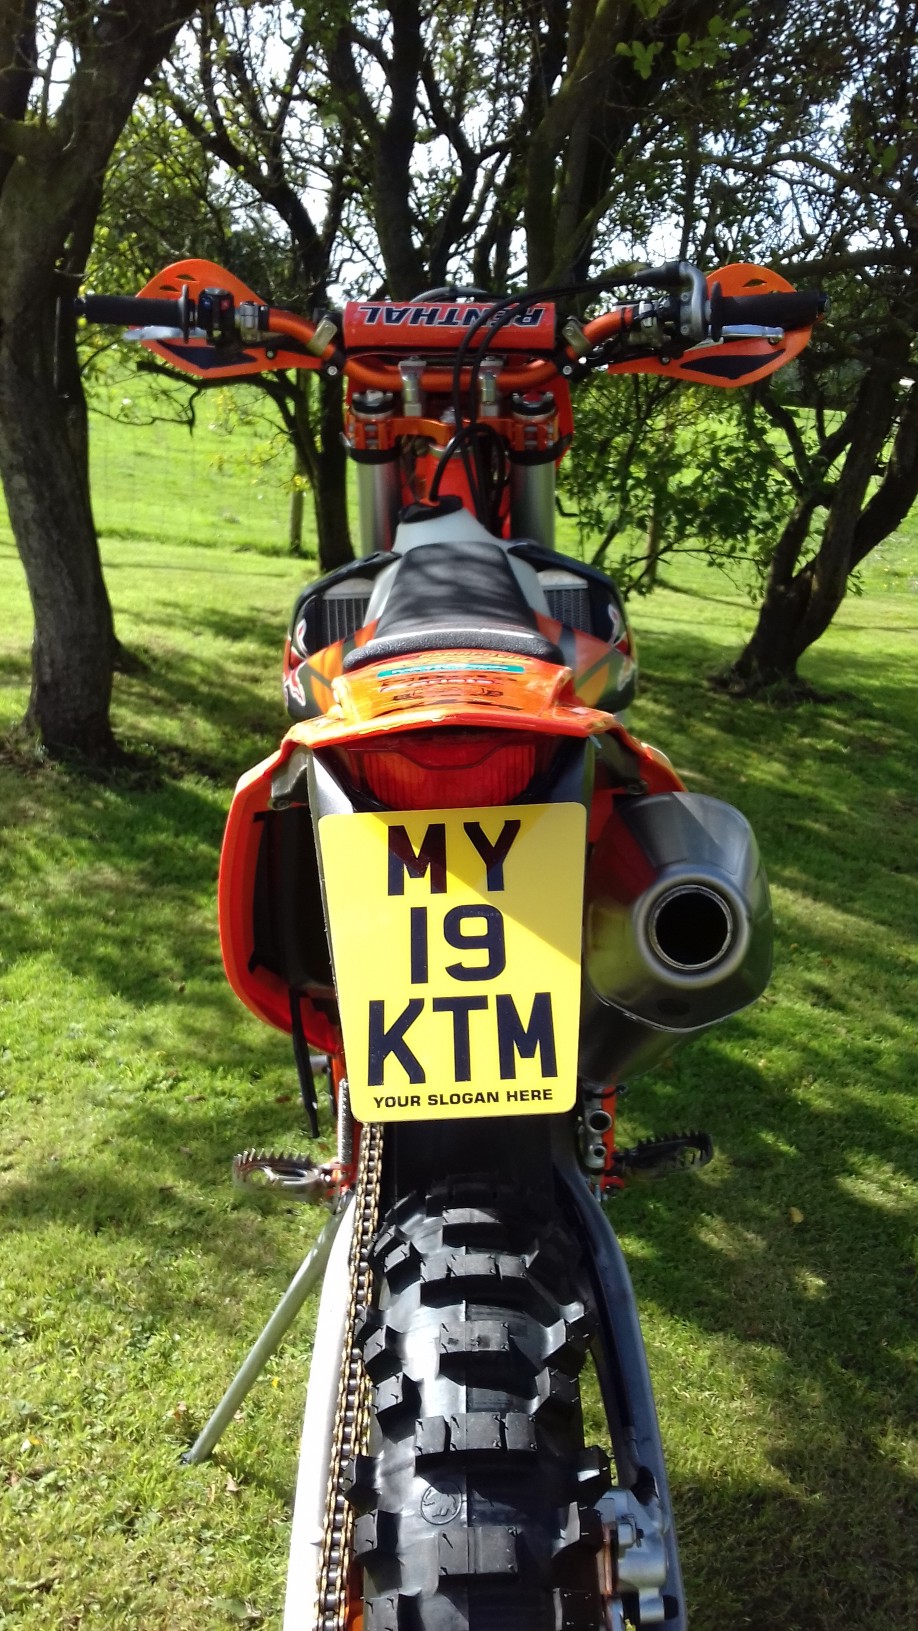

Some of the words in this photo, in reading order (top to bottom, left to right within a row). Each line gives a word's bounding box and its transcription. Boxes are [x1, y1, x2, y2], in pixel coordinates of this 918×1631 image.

[387, 819, 521, 896] MY
[410, 903, 506, 984] 19
[367, 991, 558, 1086] KTM
[373, 1095, 421, 1108] YOUR
[427, 1091, 499, 1106] SLOGAN
[506, 1088, 553, 1102] HERE
